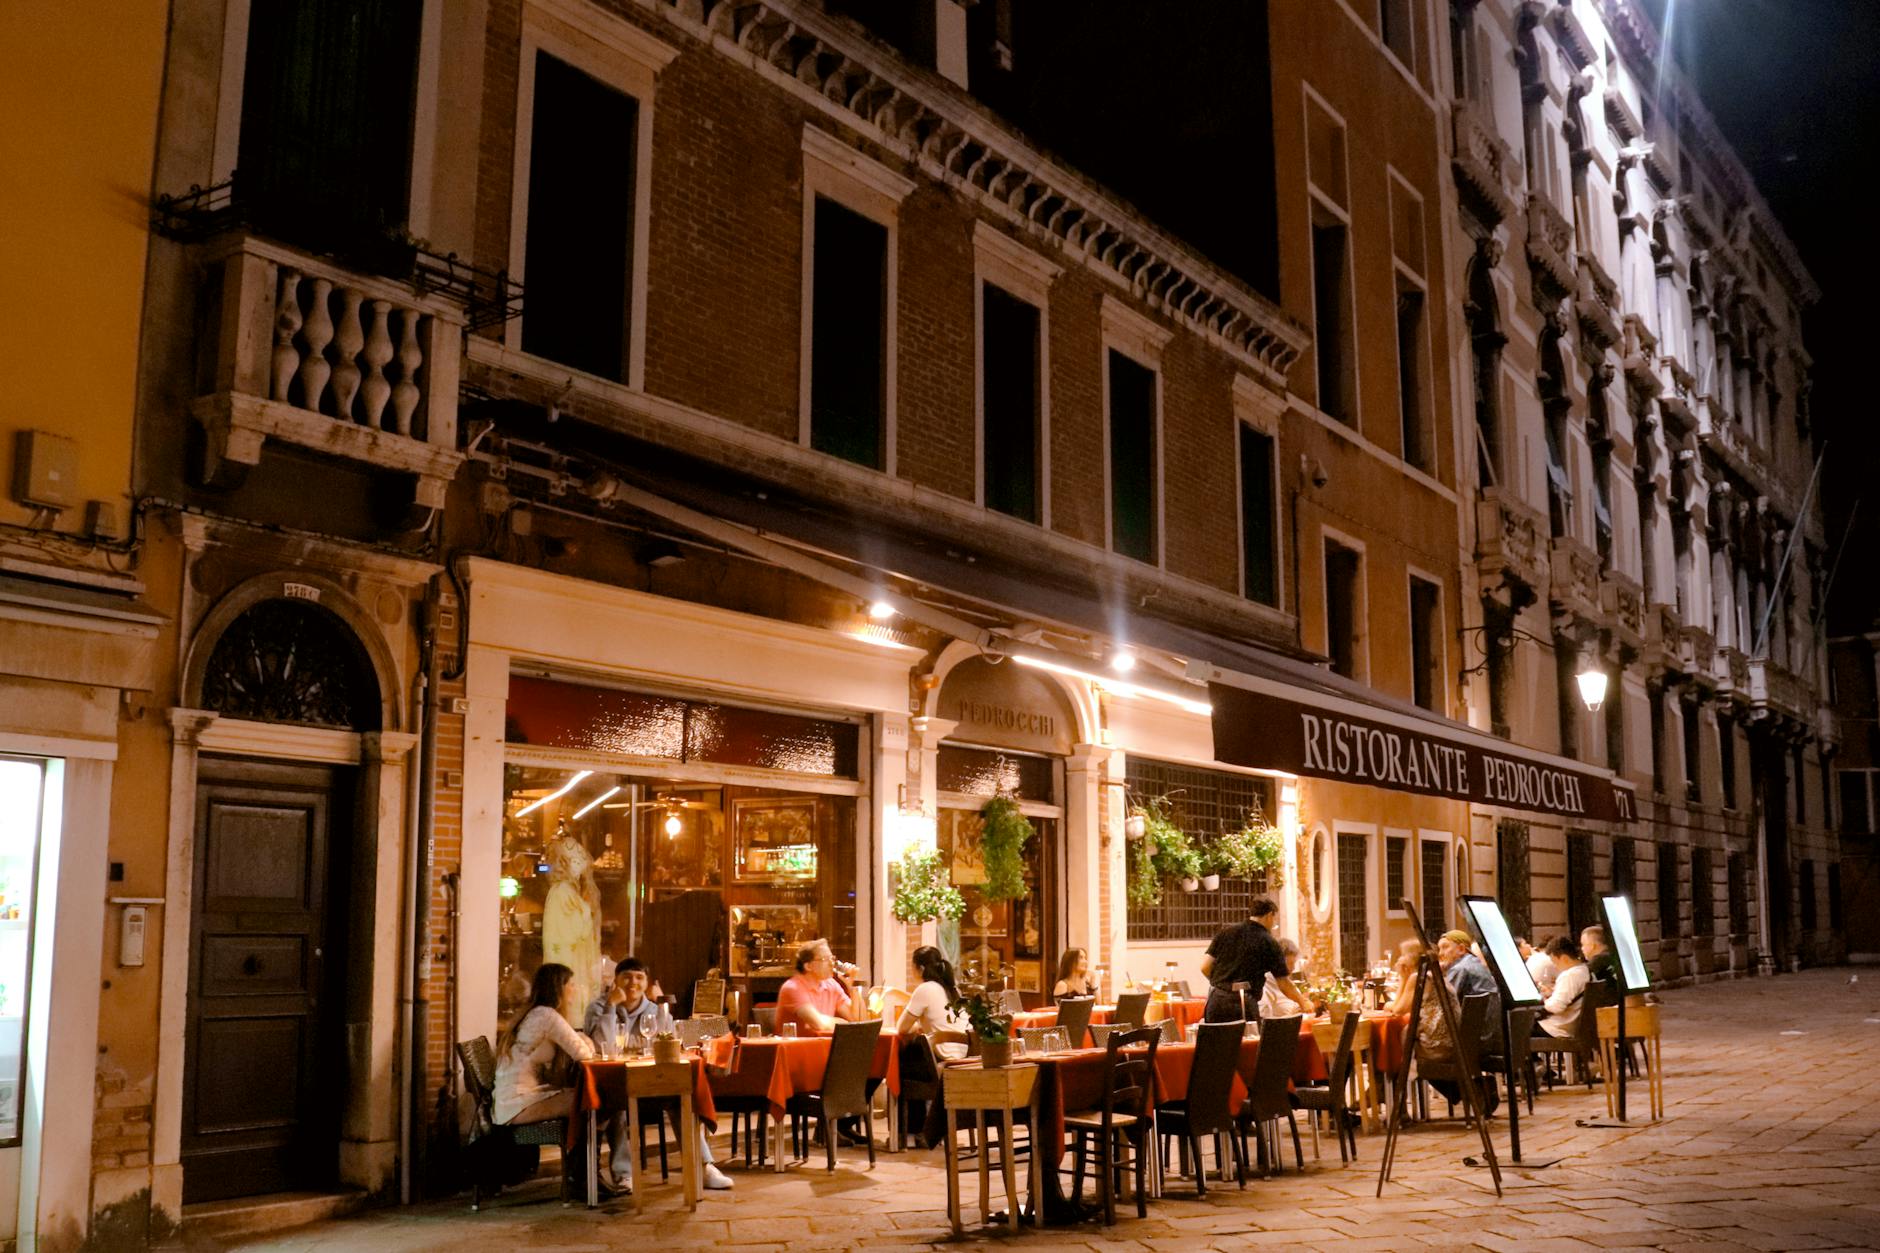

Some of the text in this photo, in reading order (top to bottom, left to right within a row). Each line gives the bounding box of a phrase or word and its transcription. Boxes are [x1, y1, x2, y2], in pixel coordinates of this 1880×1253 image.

[960, 700, 1055, 737] PEDROCCHI
[1301, 714, 1469, 795] RISTORANTE
[1482, 755, 1585, 813] PEDROCCHI
